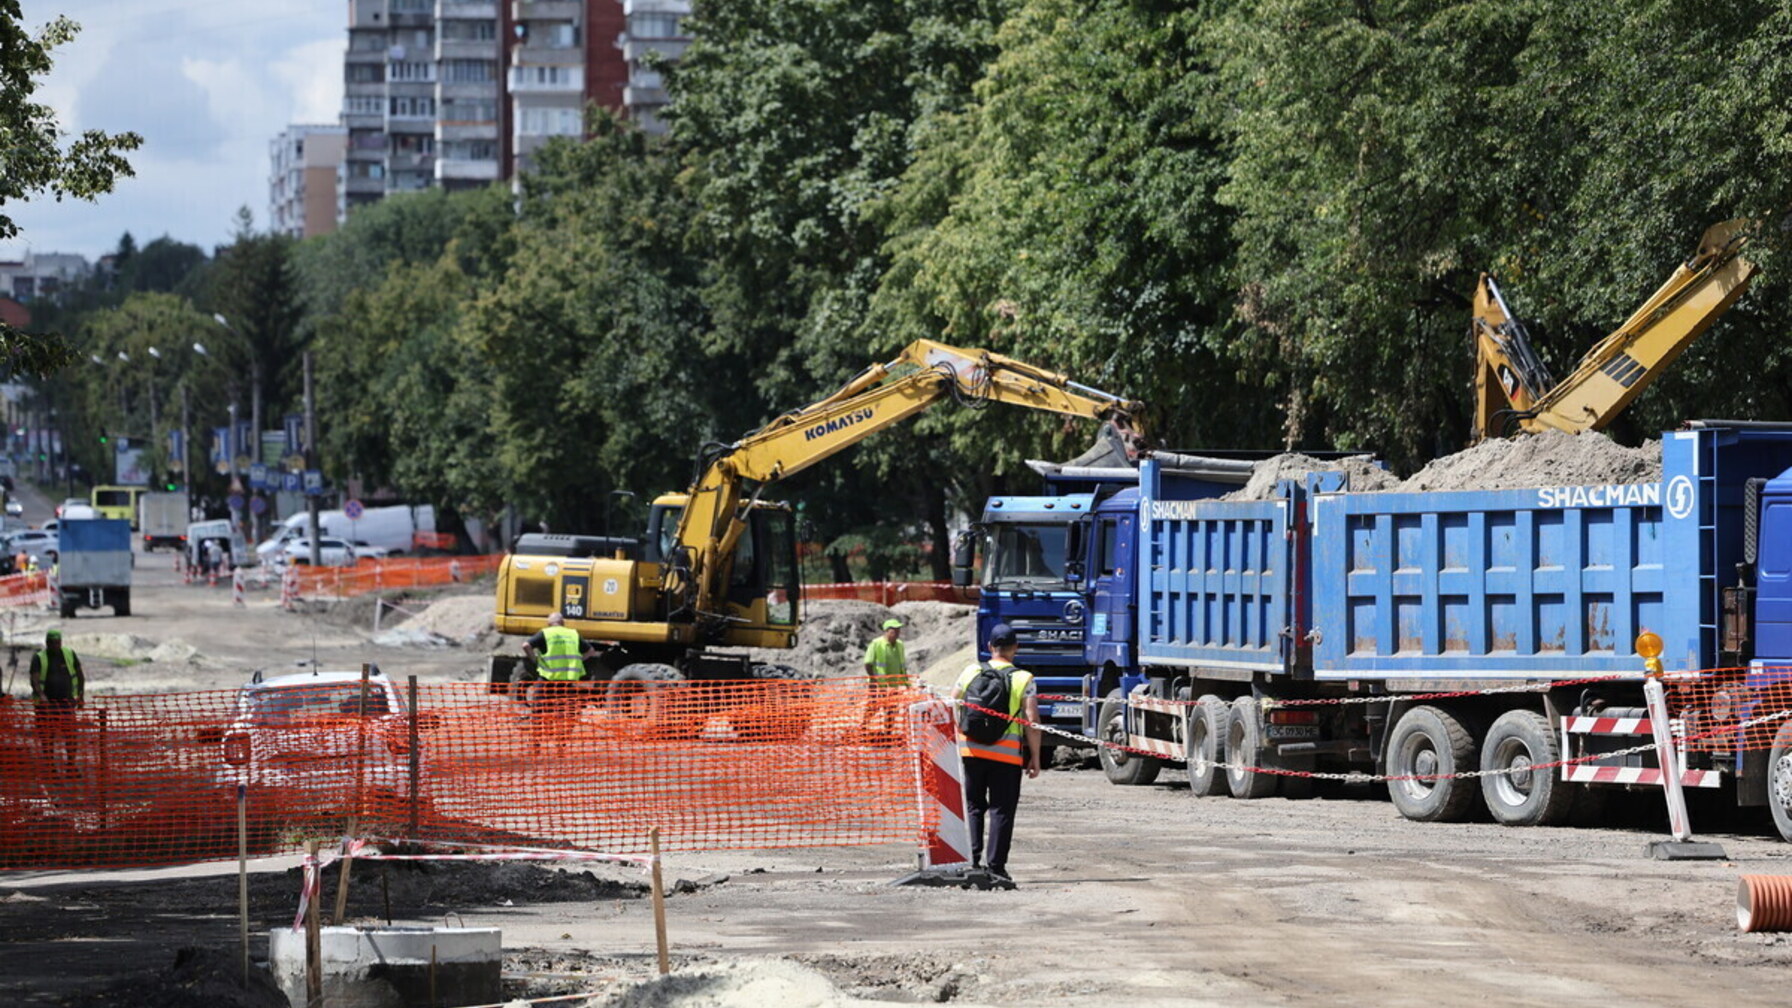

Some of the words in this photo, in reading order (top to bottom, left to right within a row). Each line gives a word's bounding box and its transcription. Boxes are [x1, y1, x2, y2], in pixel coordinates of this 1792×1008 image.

[804, 406, 873, 441] KOMATSU
[1537, 483, 1660, 507] SHACMAN
[1152, 500, 1196, 519] SHACMAN
[565, 605, 583, 616] 140
